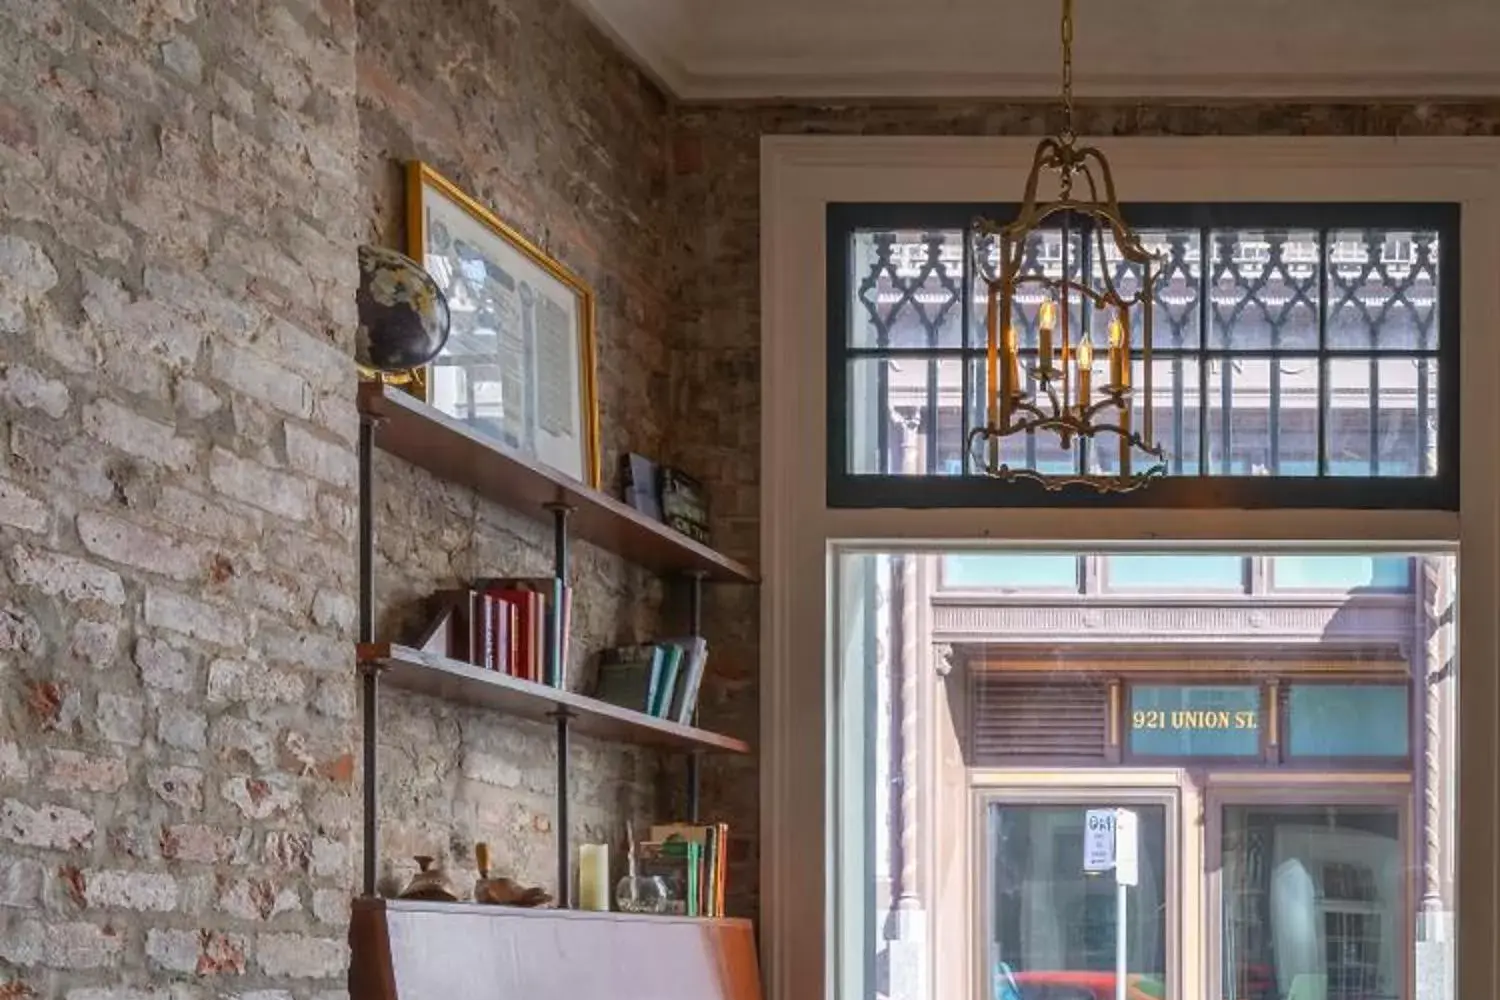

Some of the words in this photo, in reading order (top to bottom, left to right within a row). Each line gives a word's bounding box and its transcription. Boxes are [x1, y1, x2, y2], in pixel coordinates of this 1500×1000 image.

[1133, 711, 1165, 729] 921
[1171, 711, 1230, 729] UNION
[1235, 711, 1257, 729] ST.
